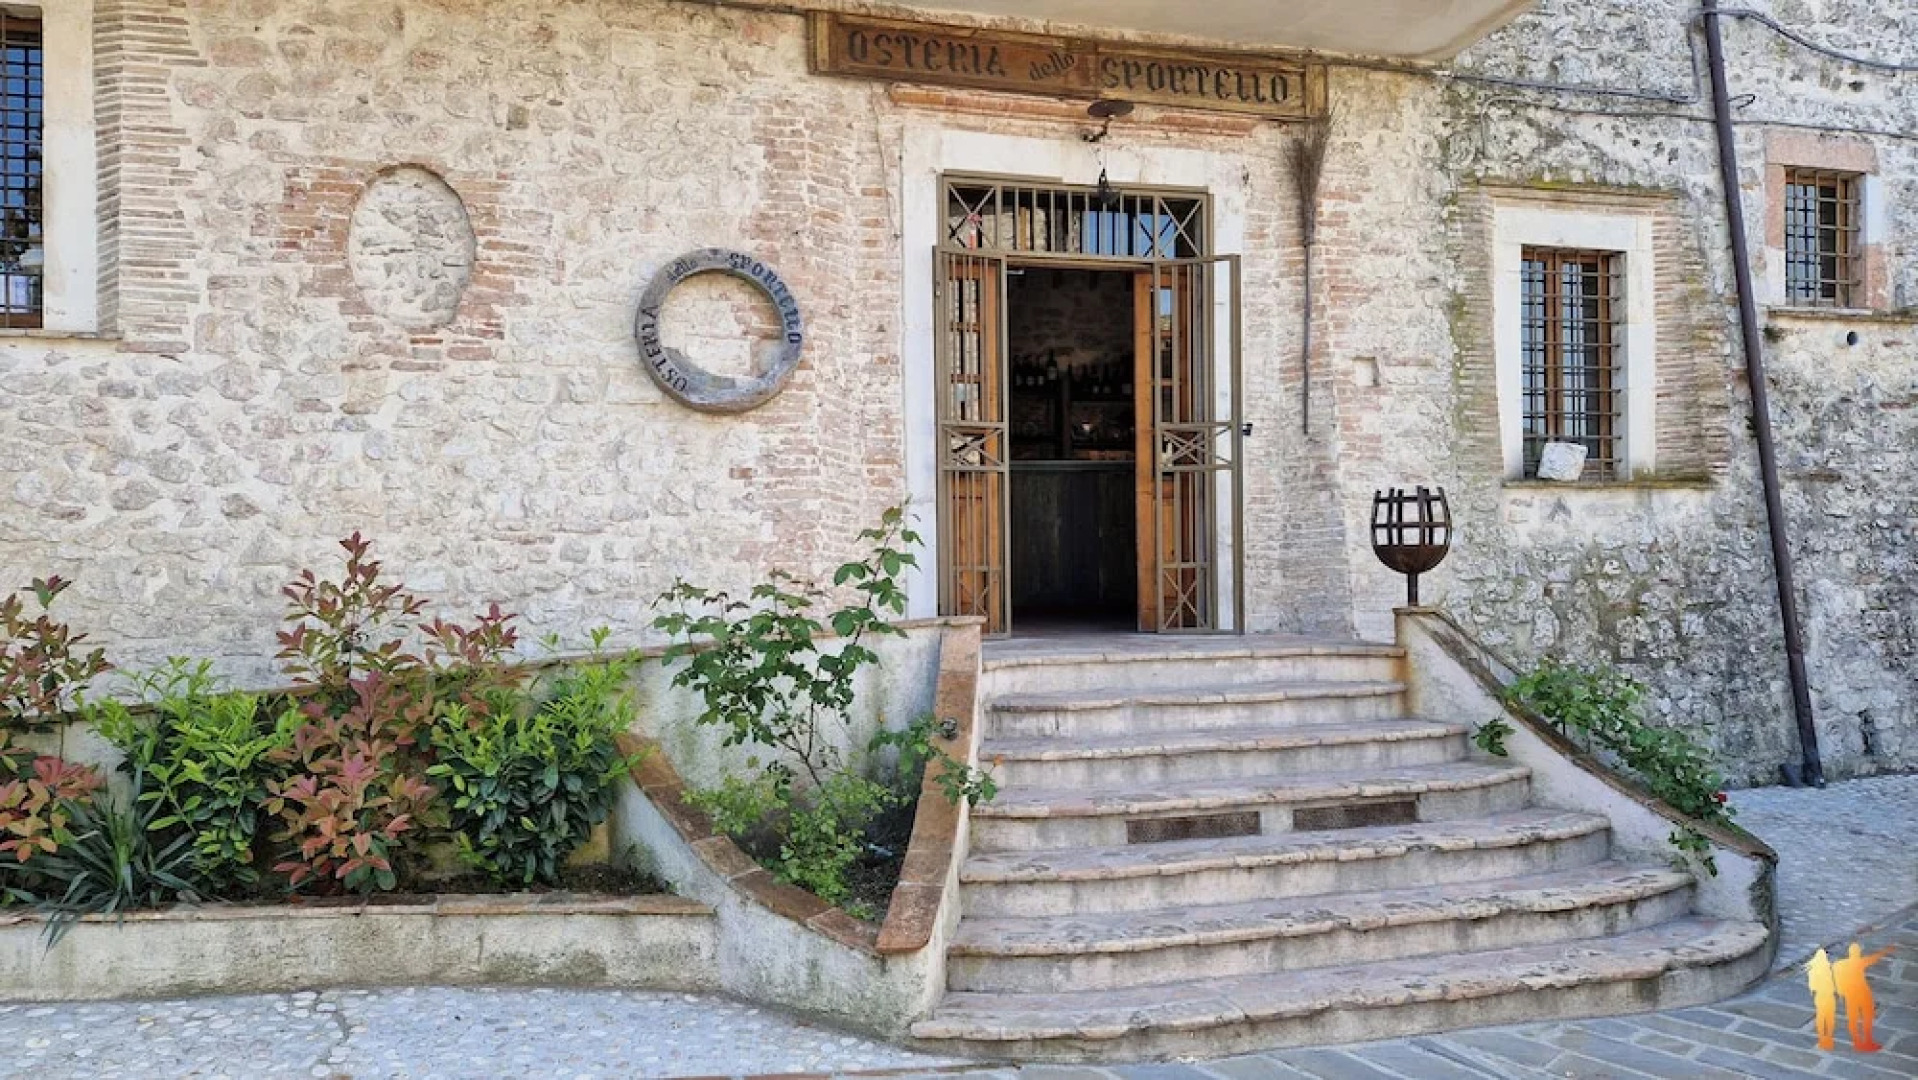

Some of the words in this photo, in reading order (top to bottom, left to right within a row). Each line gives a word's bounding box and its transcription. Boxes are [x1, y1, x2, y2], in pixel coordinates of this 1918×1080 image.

[847, 29, 1006, 78] OSTERIA
[1028, 51, 1075, 82] dello
[1101, 57, 1288, 104] SPORTELLO
[641, 304, 687, 391] OSTERIA
[667, 259, 698, 281] dello
[728, 252, 802, 344] SPORTELLO
